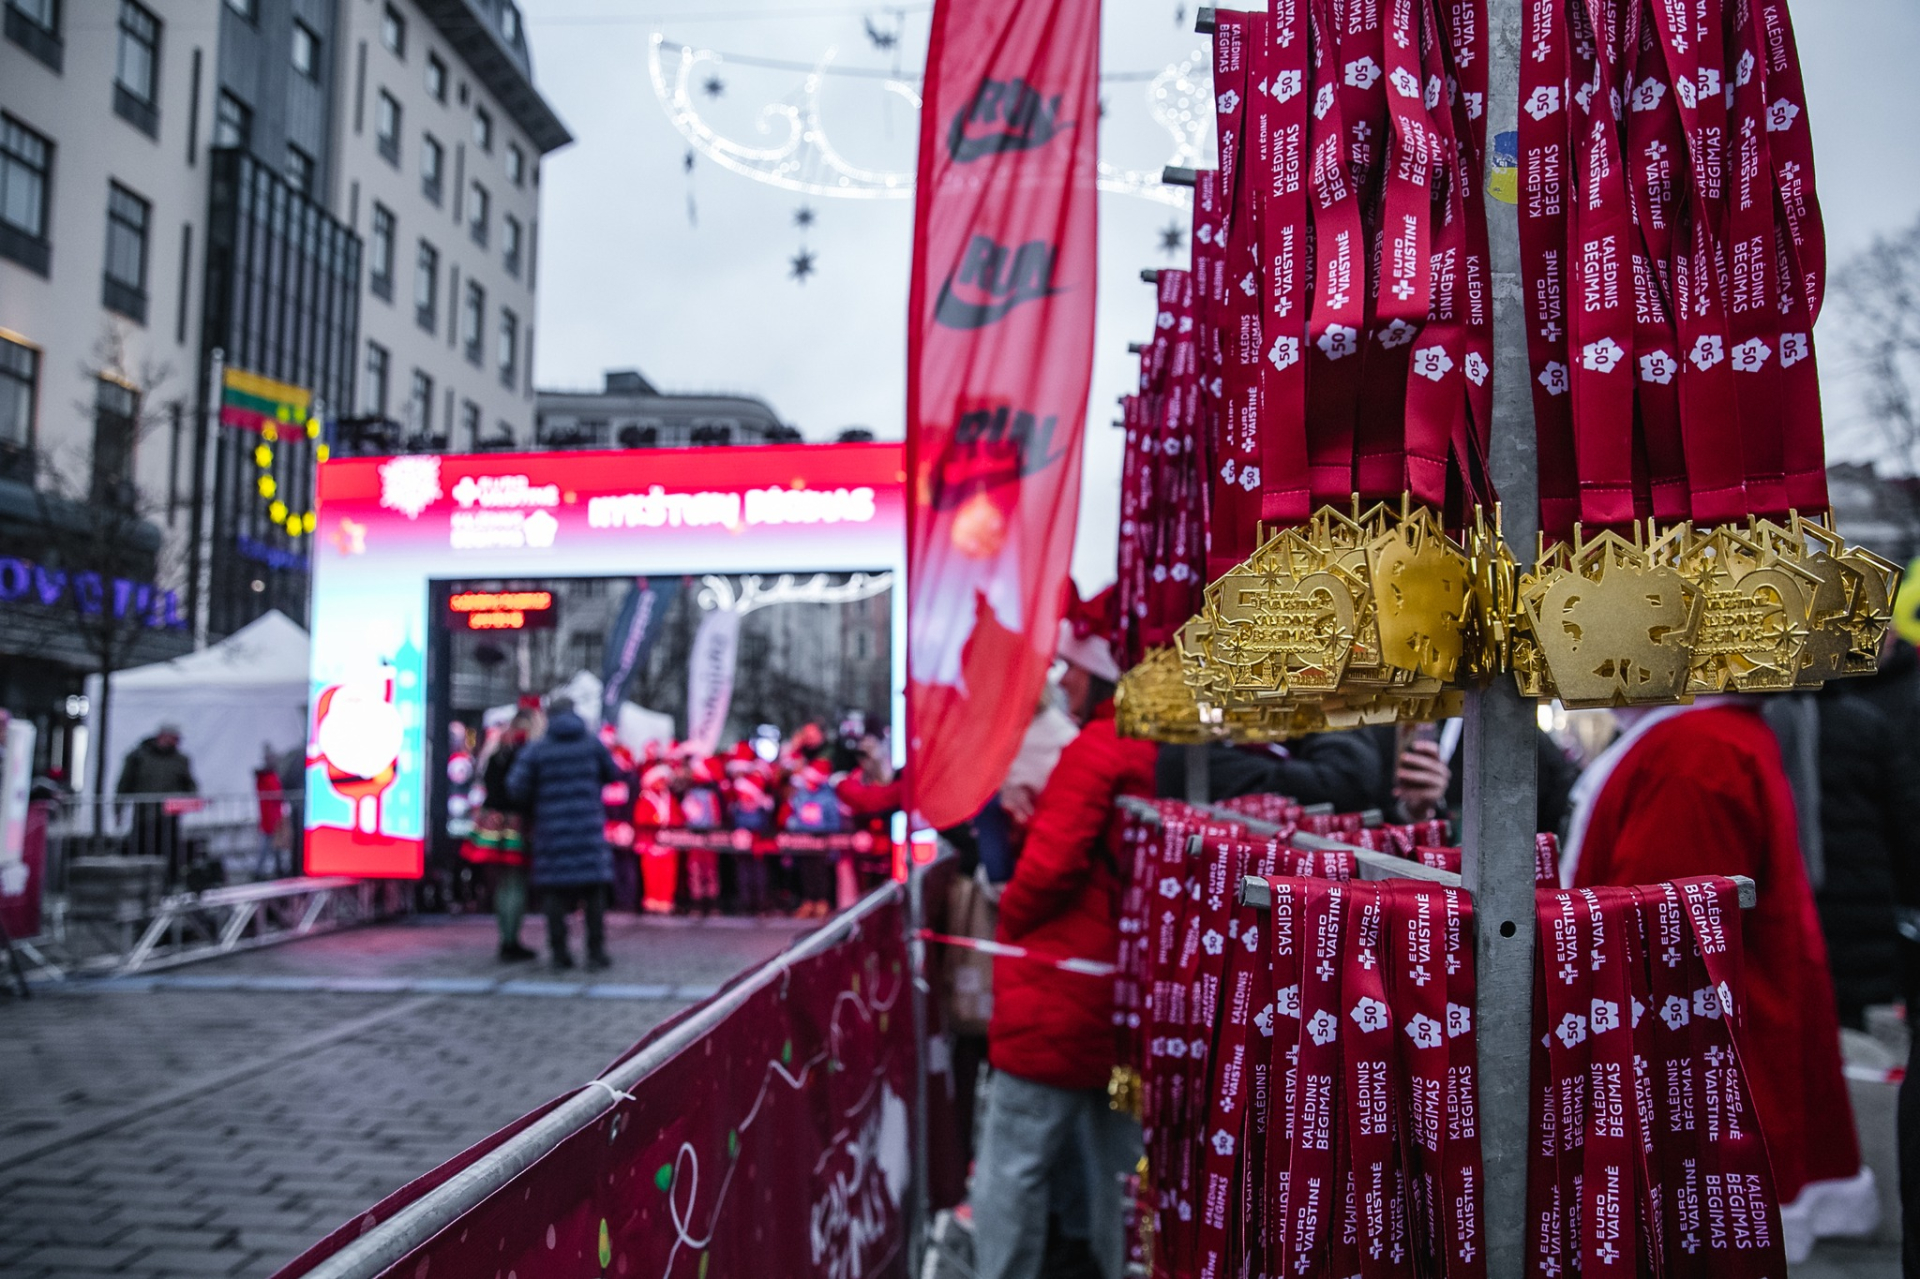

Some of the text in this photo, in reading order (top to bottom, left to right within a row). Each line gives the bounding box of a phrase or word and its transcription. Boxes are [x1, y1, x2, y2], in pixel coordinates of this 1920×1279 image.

[1452, 4, 1462, 47] EURO
[1533, 2, 1541, 42] EURO
[1763, 5, 1788, 72] KALĖDINIS
[1219, 23, 1230, 73] BĖGIMAS
[1230, 23, 1242, 71] KALĖDINIS
[1741, 59, 1748, 79] 50
[1282, 76, 1293, 94] 50
[1355, 65, 1368, 82] 50
[1401, 75, 1411, 92] 50
[1641, 86, 1654, 104] 50
[1683, 85, 1691, 102] 50
[1223, 95, 1232, 109] 50
[1319, 92, 1327, 111] 50
[1537, 93, 1550, 111] 50
[1771, 107, 1787, 126] 50
[1272, 129, 1284, 197] KALĖDINIS
[1284, 124, 1299, 193] BĖGIMAS
[1326, 133, 1347, 202] BĖGIMAS
[1398, 115, 1415, 180] KALĖDINIS
[1411, 120, 1428, 186] BĖGIMAS
[1600, 138, 1610, 178] EURO
[1706, 126, 1721, 199] BĖGIMAS
[1750, 136, 1758, 178] EURO
[1313, 143, 1332, 209] KALĖDINIS
[1460, 158, 1470, 198] EURO
[1526, 148, 1542, 218] KALĖDINIS
[1542, 144, 1560, 215] BĖGIMAS
[1589, 143, 1603, 211] VAISTINĖ
[1646, 162, 1666, 230] VAISTINĖ
[1660, 160, 1671, 201] EURO
[1741, 141, 1753, 211] VAISTINĖ
[1793, 178, 1806, 217] EURO
[1281, 224, 1293, 294] VAISTINĖ
[1335, 230, 1351, 292] VAISTINĖ
[1393, 238, 1403, 278] EURO
[1403, 214, 1417, 278] VAISTINĖ
[1328, 260, 1338, 295] EURO
[1440, 247, 1457, 319] KALĖDINIS
[1466, 255, 1483, 325] KALĖDINIS
[1543, 250, 1561, 319] VAISTINĖ
[1584, 240, 1602, 312] BĖGIMAS
[1602, 235, 1619, 309] KALĖDINIS
[1632, 254, 1650, 324] BĖGIMAS
[1733, 241, 1750, 313] BĖGIMAS
[1751, 235, 1766, 309] KALĖDINIS
[1537, 279, 1547, 320] EURO
[1279, 343, 1290, 361] 50
[1331, 333, 1346, 351] 50
[1425, 353, 1440, 372] 50
[1594, 346, 1608, 365] 50
[1701, 342, 1714, 361] 50
[1743, 346, 1756, 365] 50
[1785, 339, 1797, 359] 50
[1469, 359, 1480, 377] 50
[1551, 369, 1564, 387] 50
[1650, 358, 1665, 376] 50
[1247, 386, 1258, 437] VAISTINĖ
[1246, 471, 1255, 484] 50
[1277, 883, 1295, 956] BĖGIMAS
[1317, 915, 1327, 957] EURO
[1326, 887, 1341, 958] VAISTINĖ
[1359, 905, 1372, 946] EURO
[1408, 919, 1417, 962] EURO
[1415, 893, 1431, 963] VAISTINĖ
[1443, 889, 1460, 951] VAISTINĖ
[1554, 919, 1565, 962] EURO
[1555, 893, 1578, 961] VAISTINĖ
[1659, 903, 1669, 945] EURO
[1684, 884, 1716, 955] BĖGIMAS
[1701, 881, 1726, 953] KALĖDINIS
[1287, 992, 1299, 1010] 50
[1364, 1005, 1377, 1024] 50
[1449, 1010, 1462, 1029] 50
[1595, 1006, 1609, 1025] 50
[1670, 1003, 1683, 1022] 50
[1703, 993, 1717, 1011] 50
[1722, 990, 1731, 1009] 50
[1318, 1019, 1329, 1037] 50
[1418, 1022, 1432, 1042] 50
[1567, 1020, 1579, 1039] 50
[1254, 1064, 1266, 1133] KALĖDINIS
[1301, 1075, 1317, 1148] KALĖDINIS
[1314, 1075, 1331, 1150] BĖGIMAS
[1357, 1061, 1371, 1135] KALĖDINIS
[1371, 1061, 1387, 1134] BĖGIMAS
[1459, 1065, 1475, 1138] BĖGIMAS
[1562, 1077, 1573, 1151] KALĖDINIS
[1573, 1074, 1584, 1148] BĖGIMAS
[1591, 1062, 1607, 1137] KALĖDINIS
[1606, 1062, 1624, 1138] BĖGIMAS
[1643, 1077, 1655, 1121] EURO
[1666, 1059, 1682, 1132] KALĖDINIS
[1726, 1067, 1744, 1140] VAISTINĖ
[1732, 1068, 1743, 1113] EURO
[1424, 1079, 1440, 1152] BĖGIMAS
[1540, 1086, 1555, 1157] KALĖDINIS
[1634, 1079, 1654, 1154] VAISTINĖ
[1303, 1177, 1320, 1251] VAISTINĖ
[1366, 1192, 1374, 1237] EURO
[1370, 1161, 1383, 1235] VAISTINĖ
[1456, 1197, 1465, 1240] EURO
[1460, 1166, 1475, 1239] VAISTINĖ
[1596, 1194, 1605, 1239] EURO
[1604, 1165, 1619, 1240] VAISTINĖ
[1677, 1188, 1688, 1232] EURO
[1682, 1158, 1700, 1231] VAISTINĖ
[1726, 1173, 1752, 1249] BĖGIMAS
[1745, 1174, 1770, 1248] KALĖDINIS
[1295, 1207, 1306, 1252] EURO
[1540, 1211, 1551, 1254] EURO
[1569, 1206, 1577, 1249] EURO
